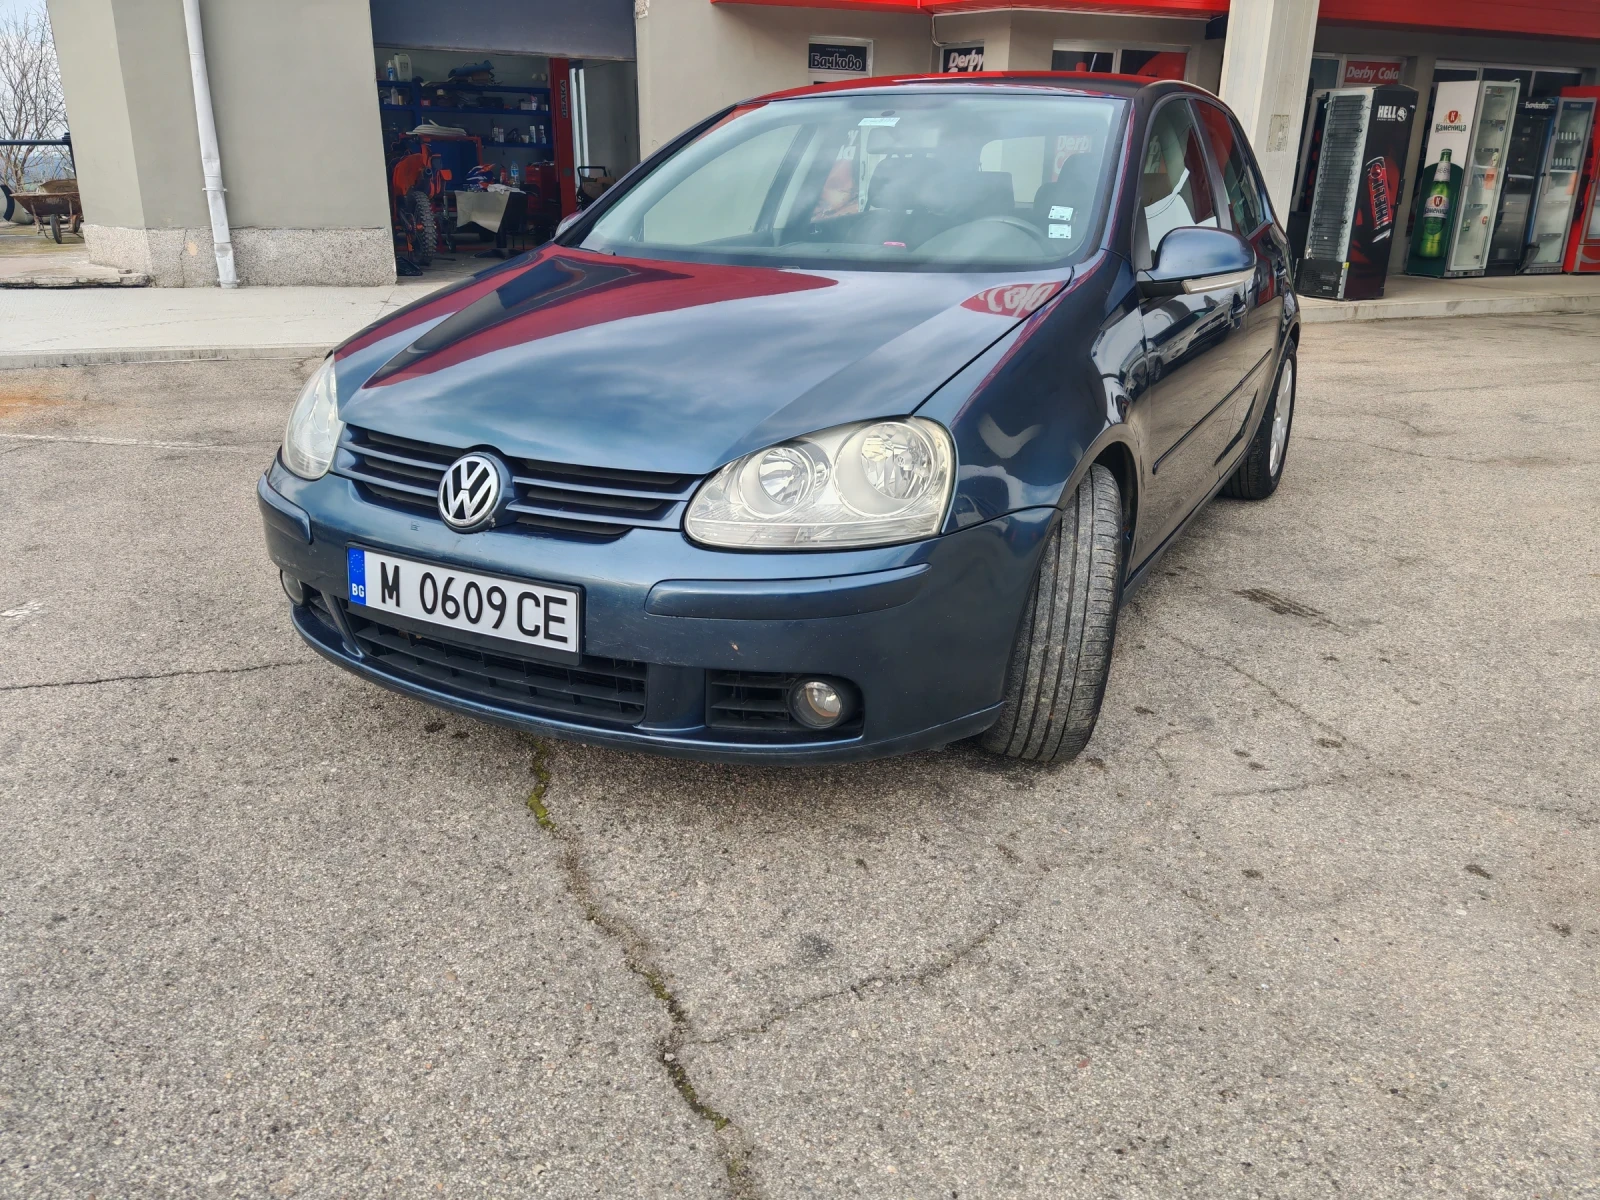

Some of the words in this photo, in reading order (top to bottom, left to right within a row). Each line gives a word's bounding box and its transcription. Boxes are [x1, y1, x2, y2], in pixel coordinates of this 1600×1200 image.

[811, 53, 862, 70] Бачково
[1346, 66, 1376, 82] Derby
[1378, 67, 1399, 80] Cola
[1377, 105, 1396, 118] HELL
[352, 583, 365, 598] BG
[380, 561, 401, 608] M
[419, 571, 507, 630] 0609
[516, 591, 568, 644] CE
